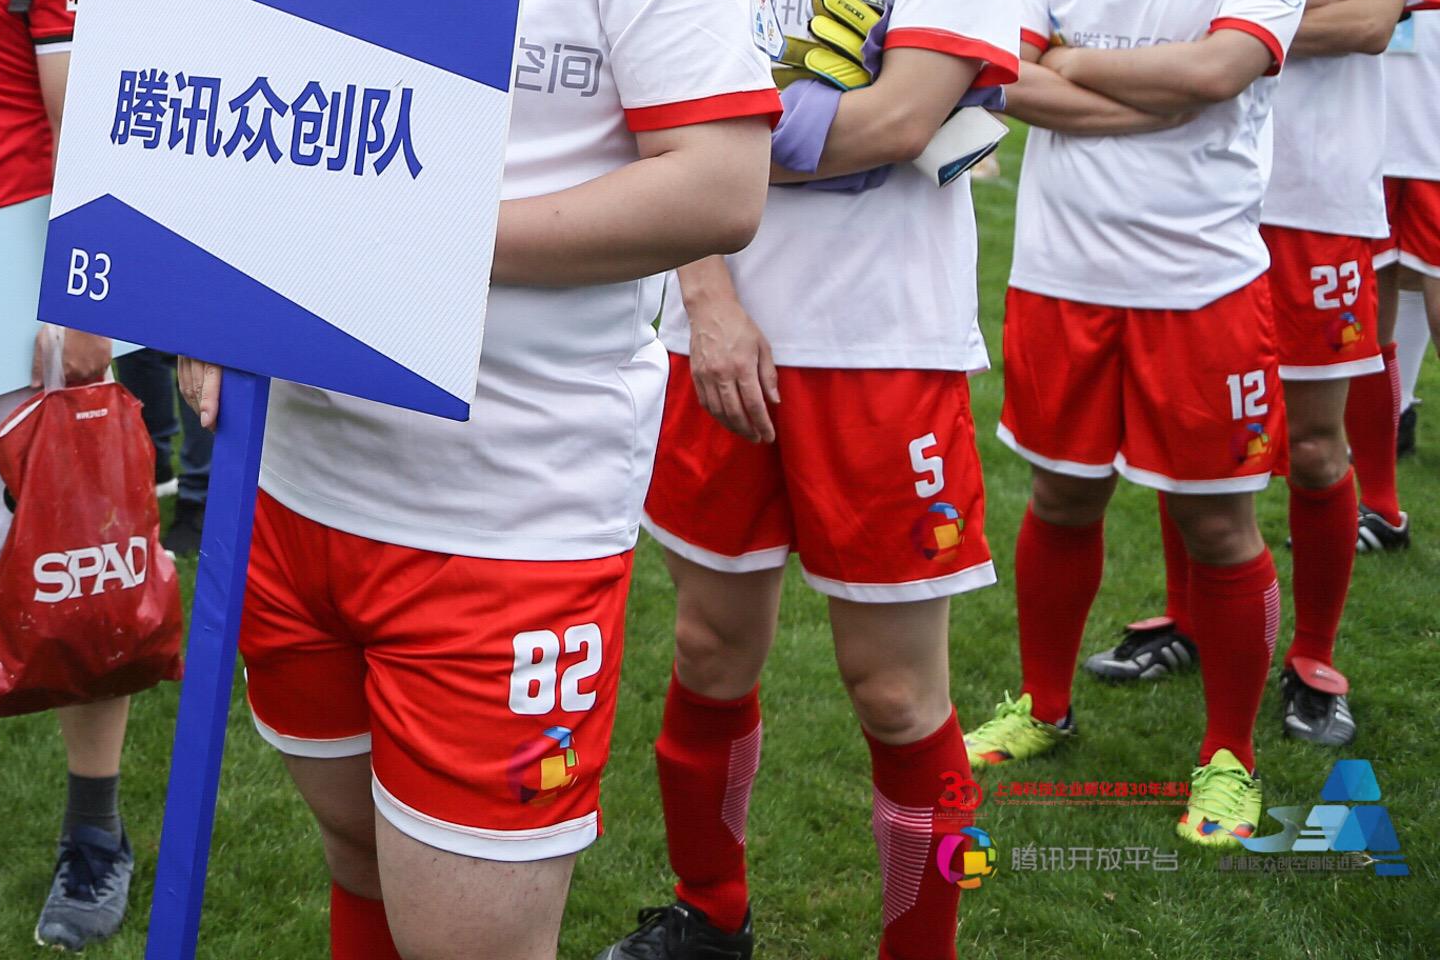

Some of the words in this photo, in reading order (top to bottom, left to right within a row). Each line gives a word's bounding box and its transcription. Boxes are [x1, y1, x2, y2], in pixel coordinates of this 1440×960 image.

[110, 69, 423, 180] 腾讯众创队
[66, 247, 112, 301] B3
[1309, 260, 1360, 310] 23
[1225, 369, 1268, 420] 12
[907, 432, 946, 499] 5
[508, 622, 603, 715] 82
